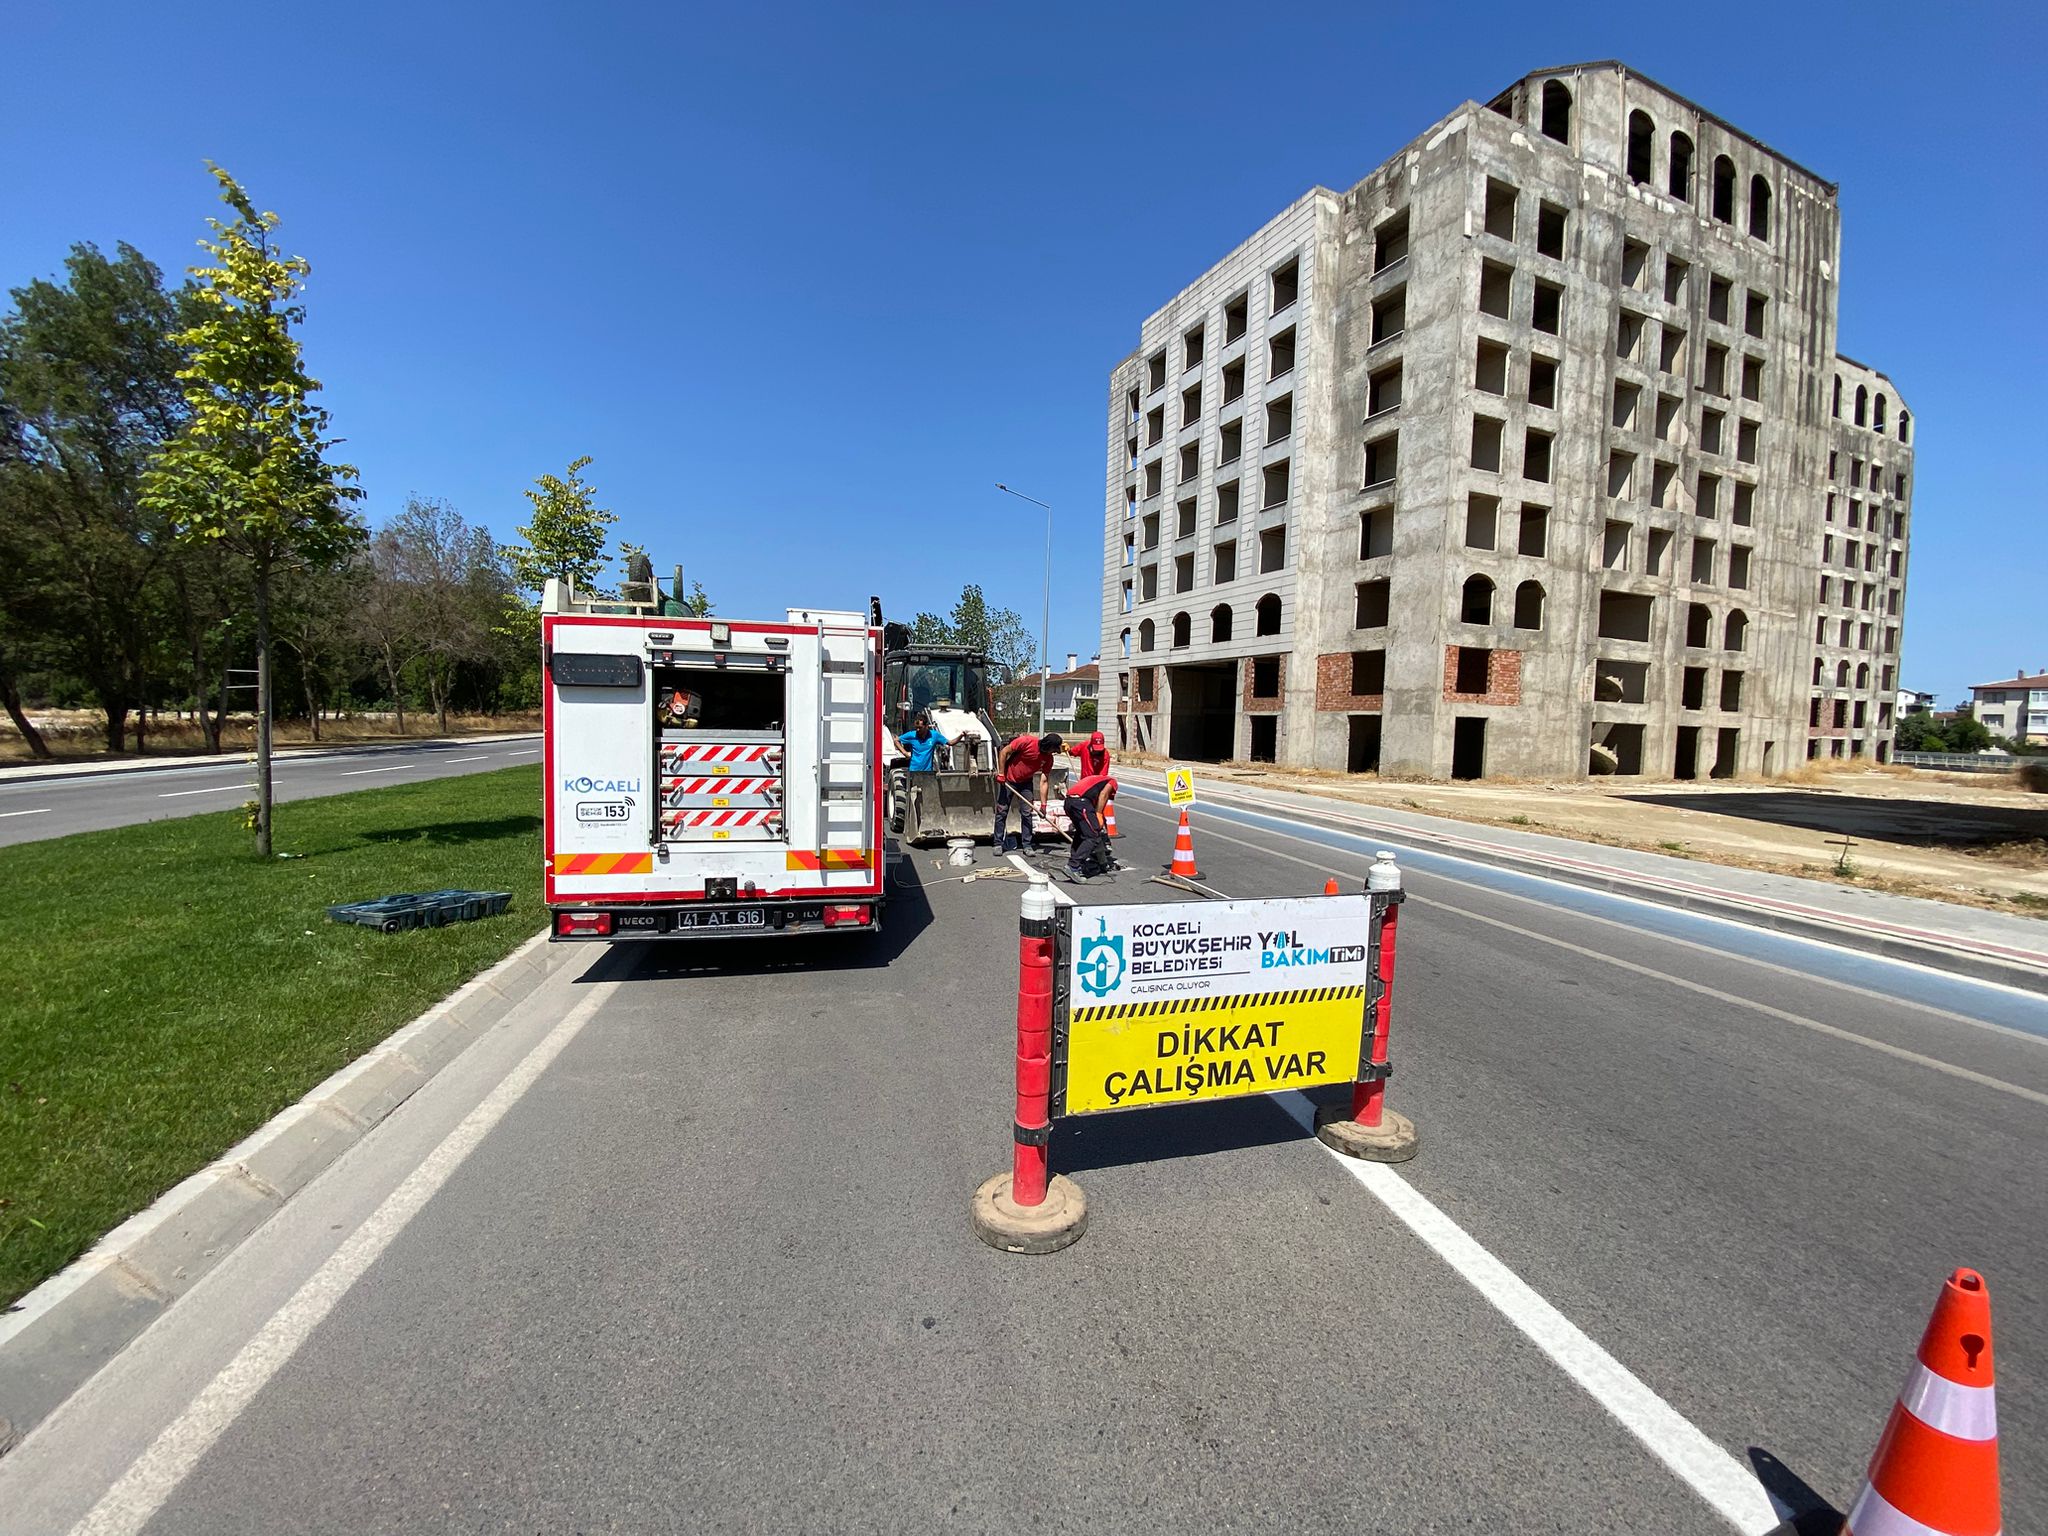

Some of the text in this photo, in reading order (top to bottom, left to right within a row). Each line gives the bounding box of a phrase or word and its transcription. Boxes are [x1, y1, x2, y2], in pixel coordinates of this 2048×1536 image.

[604, 805, 625, 818] 153
[619, 917, 655, 926] IVECO
[683, 910, 760, 926] 41 AT 616
[1257, 930, 1304, 950] YOL
[1261, 947, 1330, 969] BAKIM
[1176, 981, 1211, 990] OLUYOR
[1157, 1021, 1285, 1059] DİKKAT
[1104, 1050, 1326, 1105] ÇALIŞMA VAR
